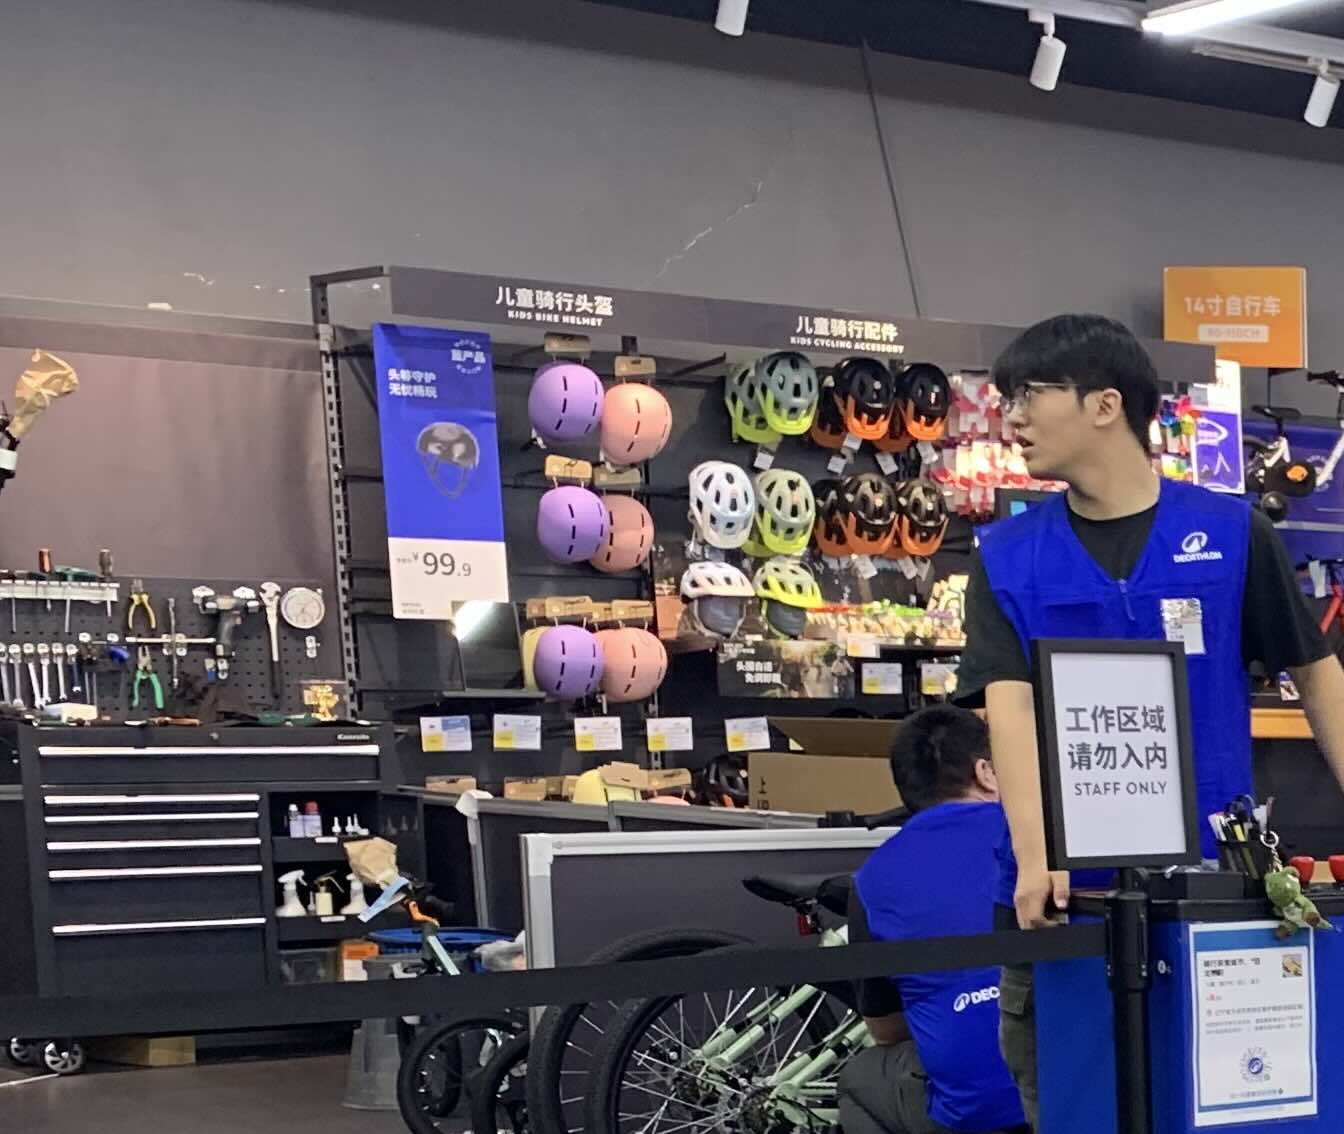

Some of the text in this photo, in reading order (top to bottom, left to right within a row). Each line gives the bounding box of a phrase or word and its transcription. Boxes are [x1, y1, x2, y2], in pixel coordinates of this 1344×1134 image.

[496, 286, 613, 316] 儿童骑行头盔
[1184, 294, 1281, 317] 14寸自行车
[796, 315, 898, 342] 儿童骑行配件
[1173, 551, 1223, 563] DECATHLON
[1065, 705, 1167, 734] 工作区域
[1068, 742, 1168, 770] 请勿入内
[1074, 781, 1168, 796] STAFF ONLY
